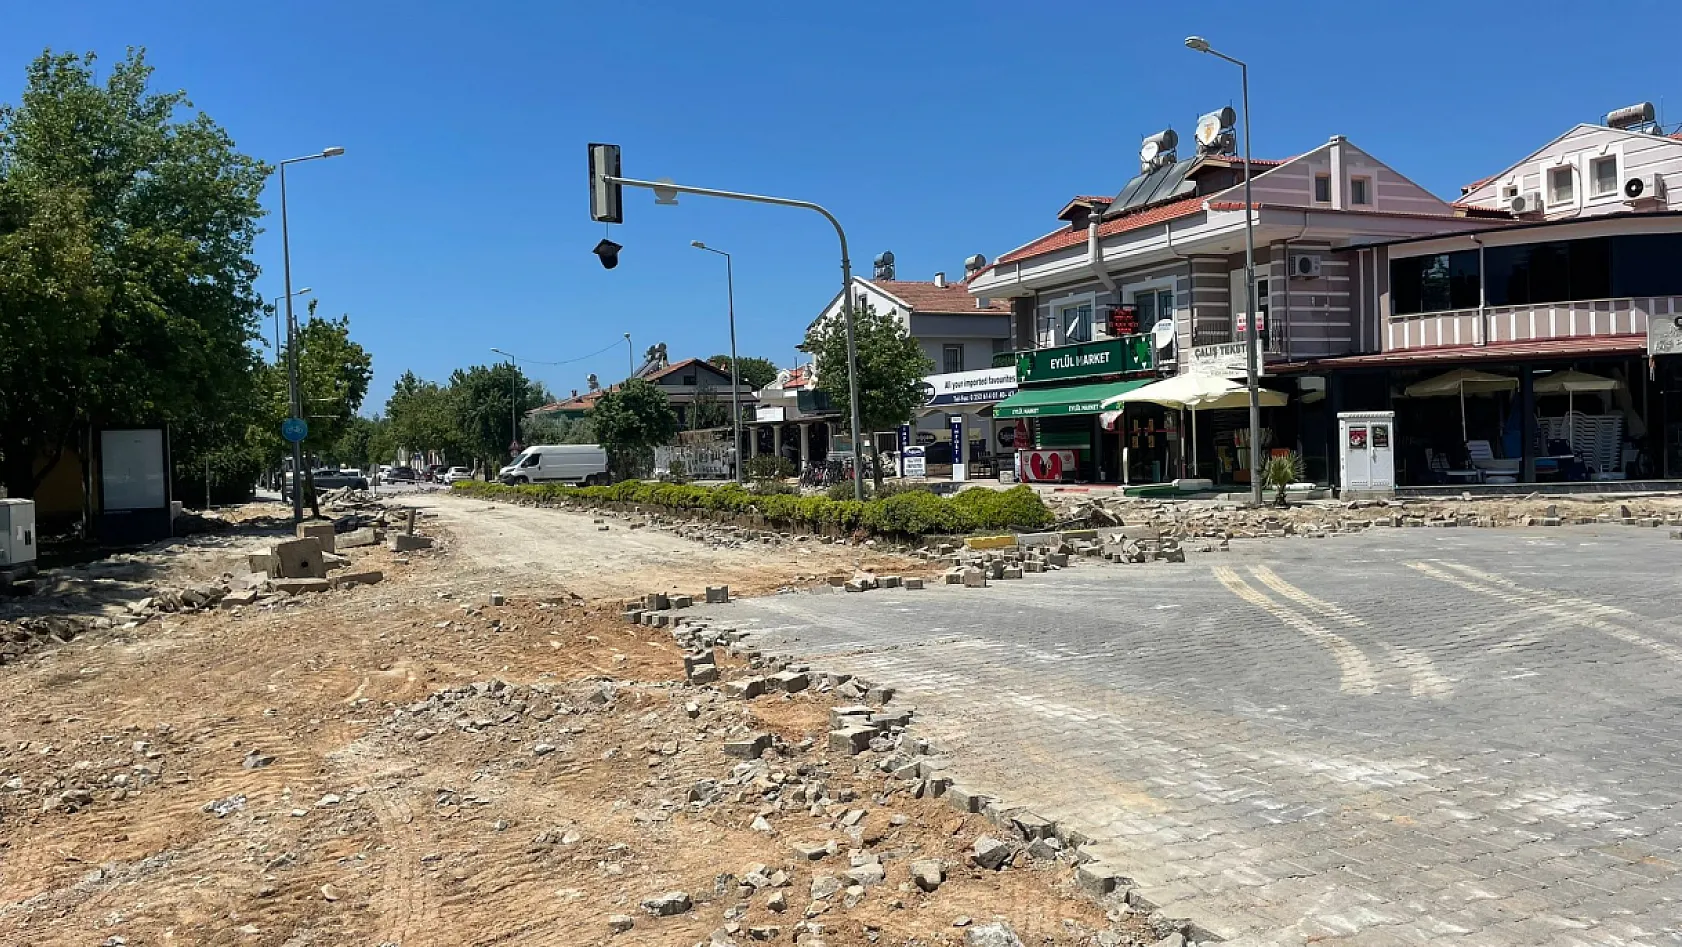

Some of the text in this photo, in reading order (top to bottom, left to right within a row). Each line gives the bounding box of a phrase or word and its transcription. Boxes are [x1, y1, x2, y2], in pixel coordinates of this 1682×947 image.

[1050, 351, 1110, 370] EYLÜL MARKET
[952, 380, 964, 390] your
[964, 376, 988, 388] imported
[988, 374, 1015, 385] favourites
